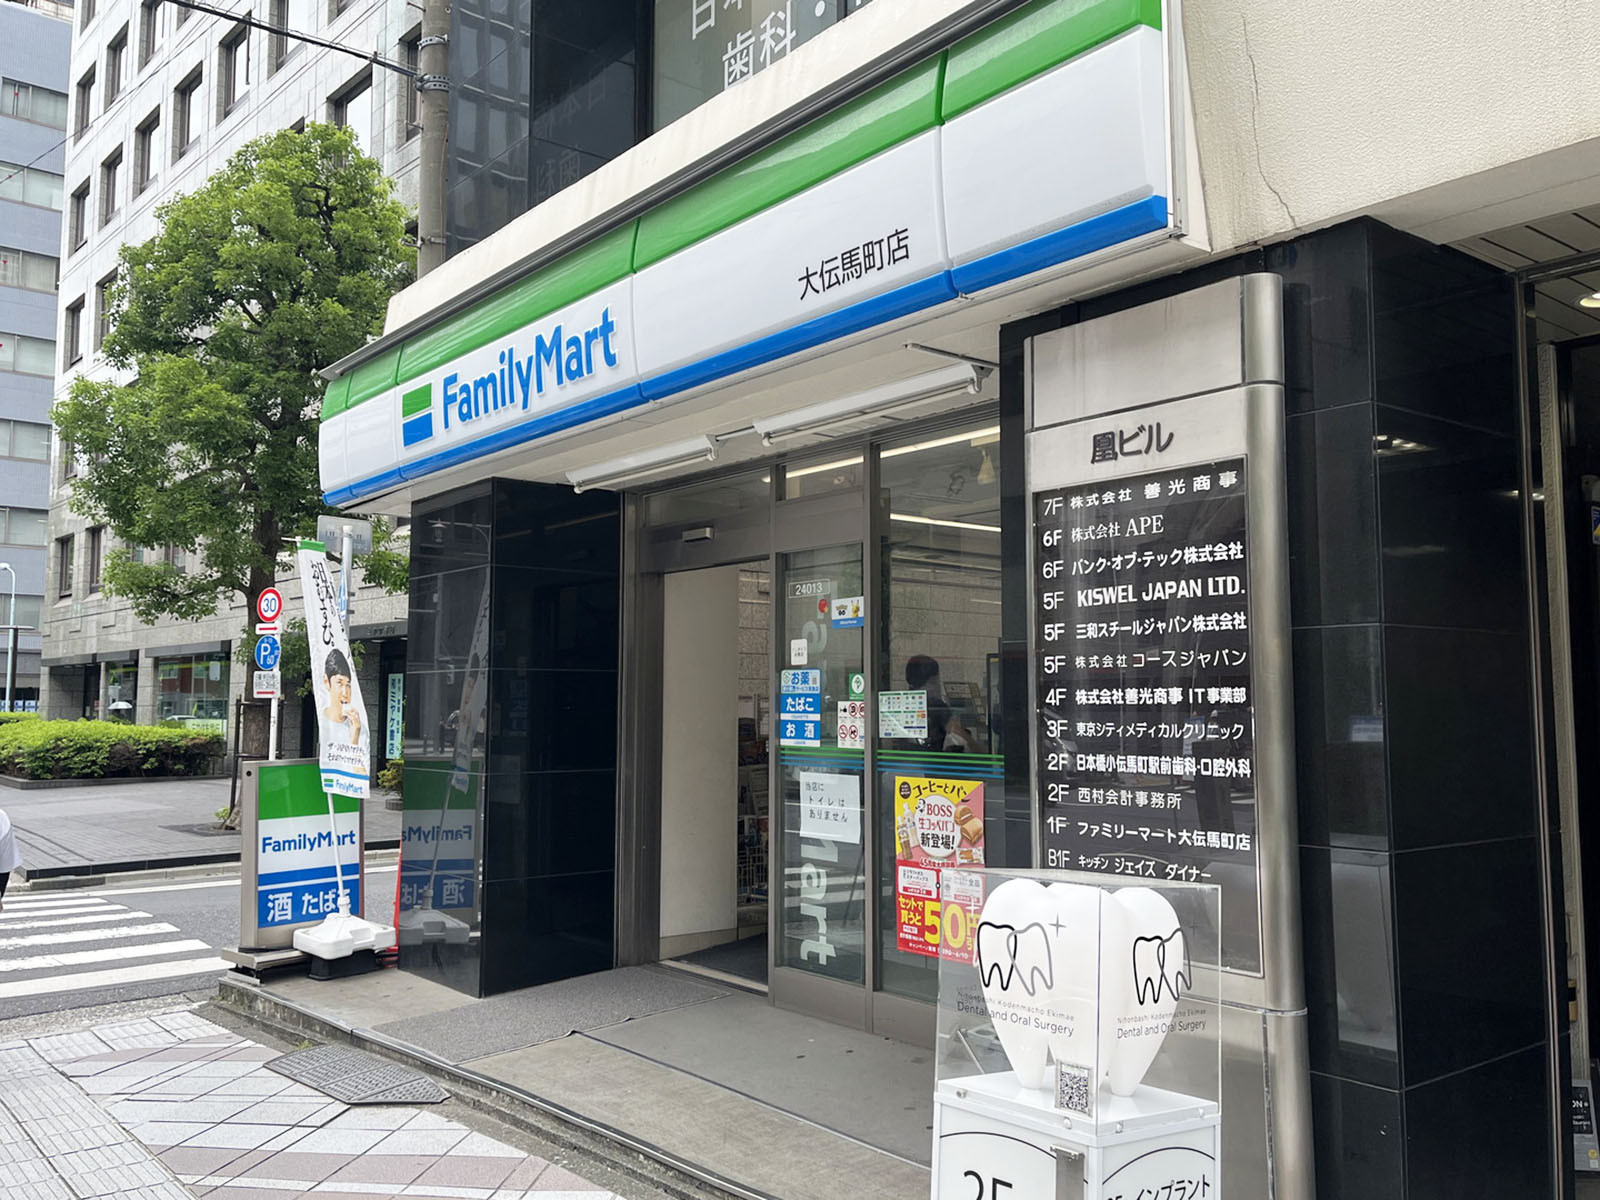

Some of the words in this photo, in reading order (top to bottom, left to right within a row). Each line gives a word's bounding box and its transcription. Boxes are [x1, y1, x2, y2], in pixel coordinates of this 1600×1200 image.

[798, 228, 909, 300] 大伝馬町店
[442, 306, 617, 430] FamilyMart
[1043, 497, 1063, 516] 7F
[1070, 488, 1132, 509] 株式会社
[1043, 529, 1063, 547] 6F
[1071, 522, 1121, 543] 株式会社
[1125, 514, 1165, 537] APE
[1043, 560, 1064, 579] 6F
[1071, 541, 1244, 576] バンク・オブ・テック株式会社
[795, 582, 823, 595] 24013
[1043, 591, 1064, 610] 5F
[1077, 584, 1138, 608] KISWEL
[1142, 578, 1203, 602] JAPAN
[1208, 575, 1246, 597] LTD.
[262, 597, 277, 613] 30
[1044, 623, 1066, 641] 5F
[1076, 611, 1247, 640] 三和スチールジャパン株式会社
[260, 643, 271, 665] P
[1044, 655, 1066, 673] 5F
[1075, 653, 1128, 669] 株式会社
[1132, 649, 1247, 669] コースジャパン
[791, 671, 809, 685] お薬
[786, 697, 815, 712] たばこ
[1045, 688, 1067, 706] 4F
[1075, 687, 1183, 705] 株式会社善光商事
[1046, 720, 1068, 738] 3F
[1076, 721, 1245, 740] 東京シティメディカルクリニック
[1047, 753, 1068, 771] 2F
[809, 796, 845, 807] トイレは
[1047, 784, 1070, 802] 2F
[1078, 787, 1183, 810] 西村会計事務所
[809, 809, 848, 823] ありません
[926, 803, 953, 818] BOSS
[1047, 816, 1067, 834] 1F
[1077, 821, 1251, 851] ファミリーマート大伝馬町店
[1048, 848, 1070, 868] B1F
[1078, 853, 1108, 870] キッチン
[1114, 858, 1156, 877] ジェイズ
[1165, 864, 1212, 882] ダイナー
[267, 892, 292, 922] 酒
[898, 896, 924, 911] セットで
[900, 909, 922, 926] 買うと
[957, 1001, 988, 1017] Dental
[990, 1011, 1007, 1021] and
[1010, 1013, 1031, 1026] Oral
[1034, 1018, 1074, 1037] Surgery
[1047, 1009, 1075, 1021] Ekimae
[1117, 1026, 1143, 1039] Dental
[1144, 1024, 1159, 1035] and
[1161, 1022, 1177, 1033] Oral
[1178, 1021, 1206, 1031] Surgery
